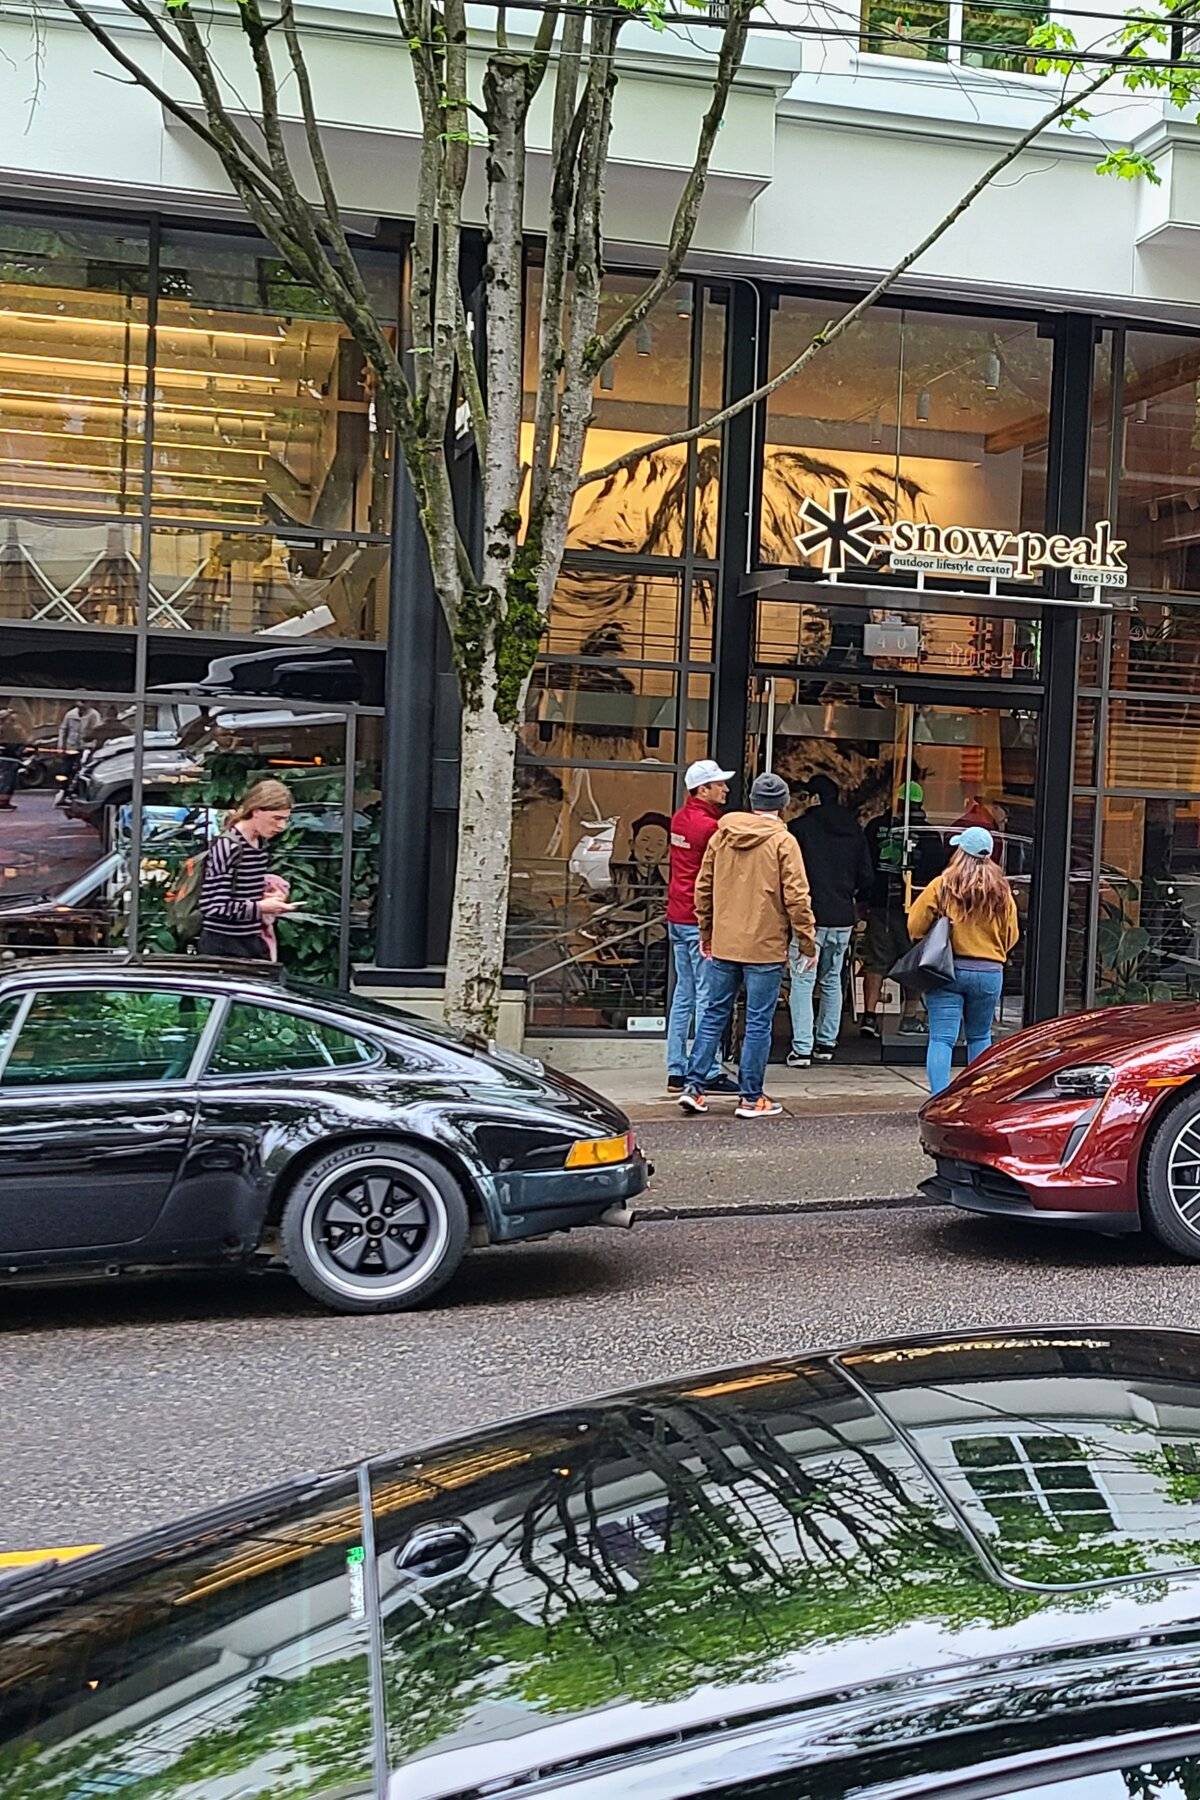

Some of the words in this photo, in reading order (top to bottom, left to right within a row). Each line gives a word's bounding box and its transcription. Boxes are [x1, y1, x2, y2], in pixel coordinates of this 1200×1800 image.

[893, 520, 1011, 561] snow
[1014, 520, 1128, 579] peak
[893, 556, 934, 569] outdoor
[936, 558, 974, 574] lifestyle
[976, 563, 1011, 575] creator
